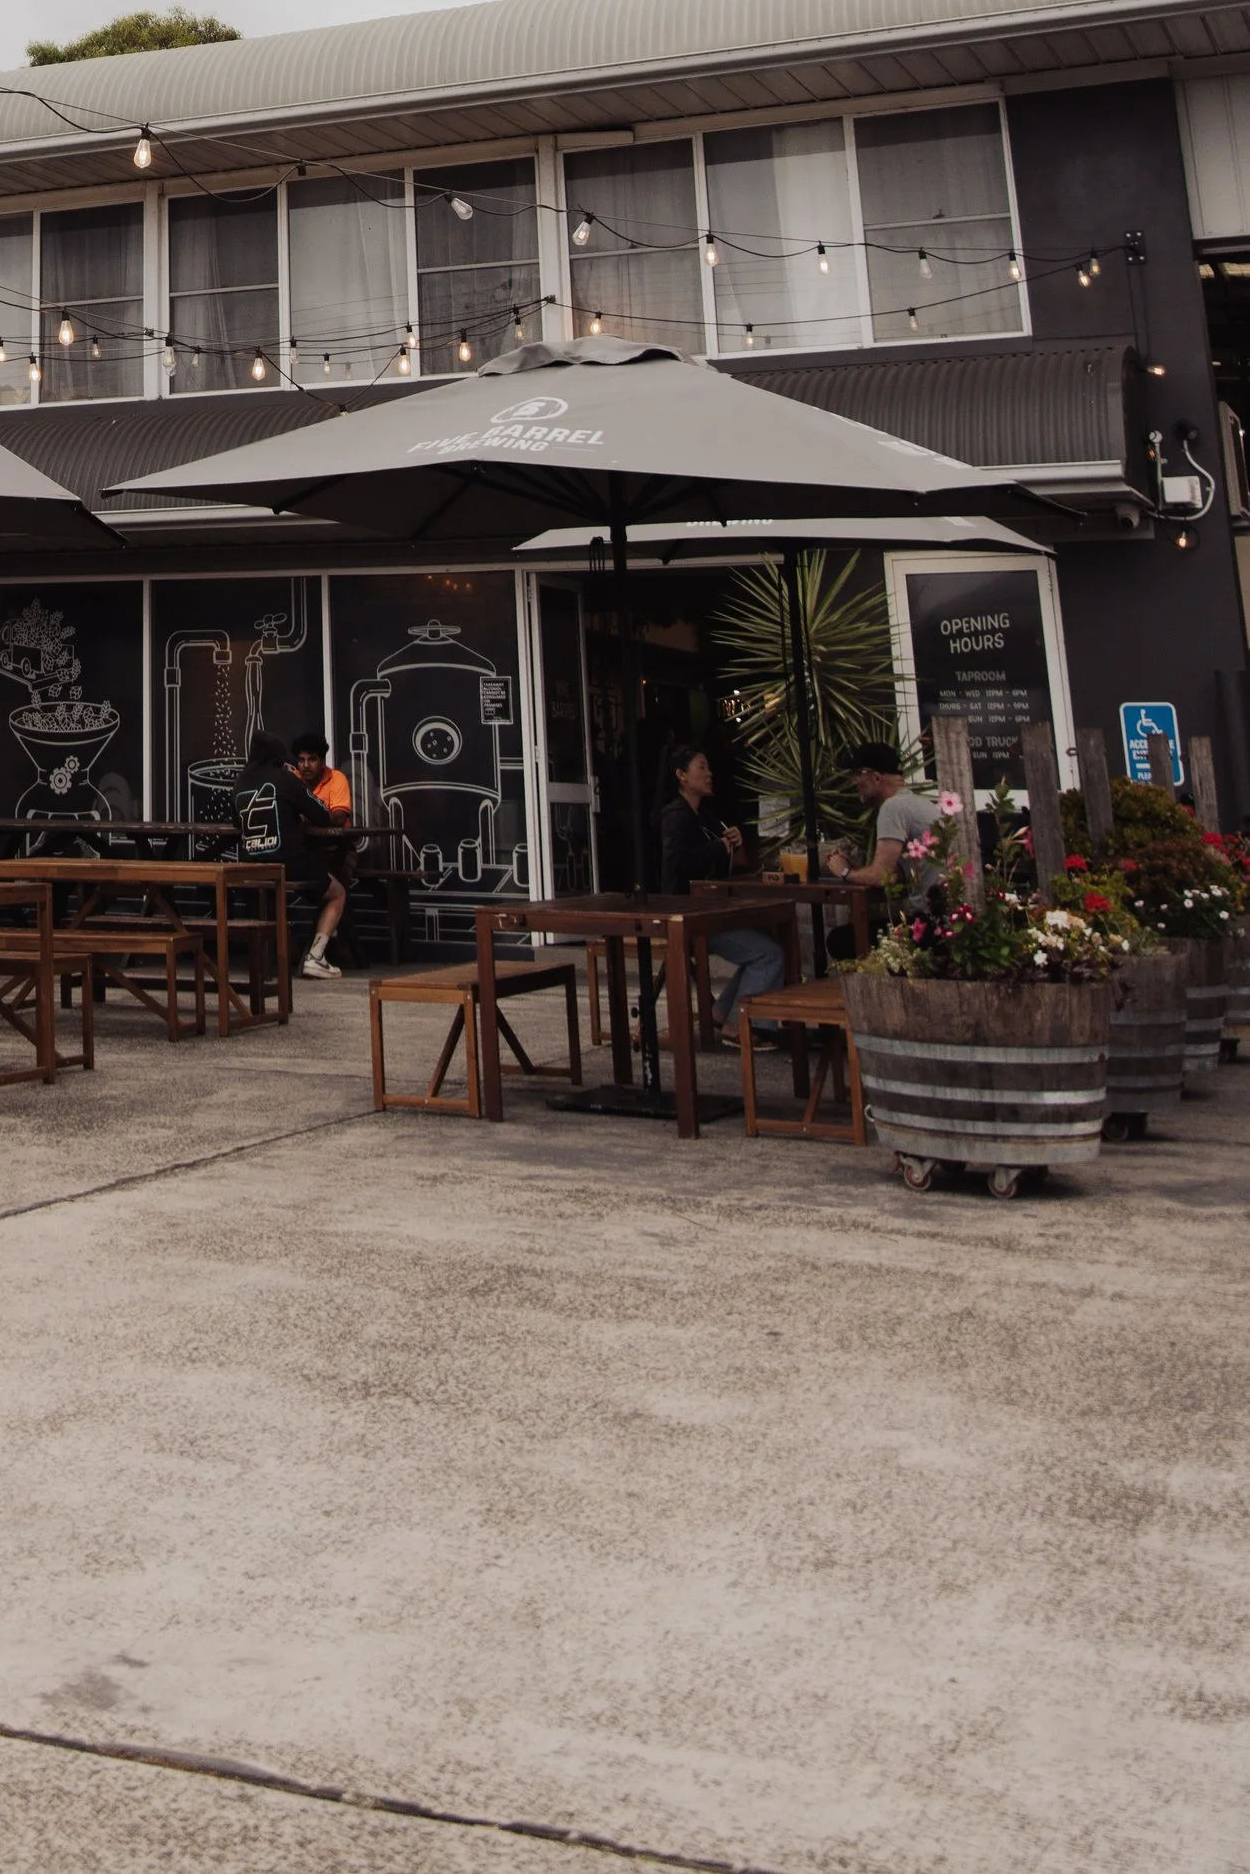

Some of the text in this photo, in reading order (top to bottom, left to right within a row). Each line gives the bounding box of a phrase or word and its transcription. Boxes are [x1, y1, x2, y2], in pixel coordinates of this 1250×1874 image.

[405, 424, 606, 453] FIVE BARREL
[436, 436, 550, 455] BREWING
[940, 612, 1011, 635] OPENING
[949, 632, 1005, 654] HOURS
[955, 670, 1007, 682] TAPROOM
[939, 689, 956, 697] MON
[965, 689, 980, 697] WED
[939, 702, 961, 710] THURS
[969, 702, 982, 710] SAT
[967, 714, 983, 723] SUN
